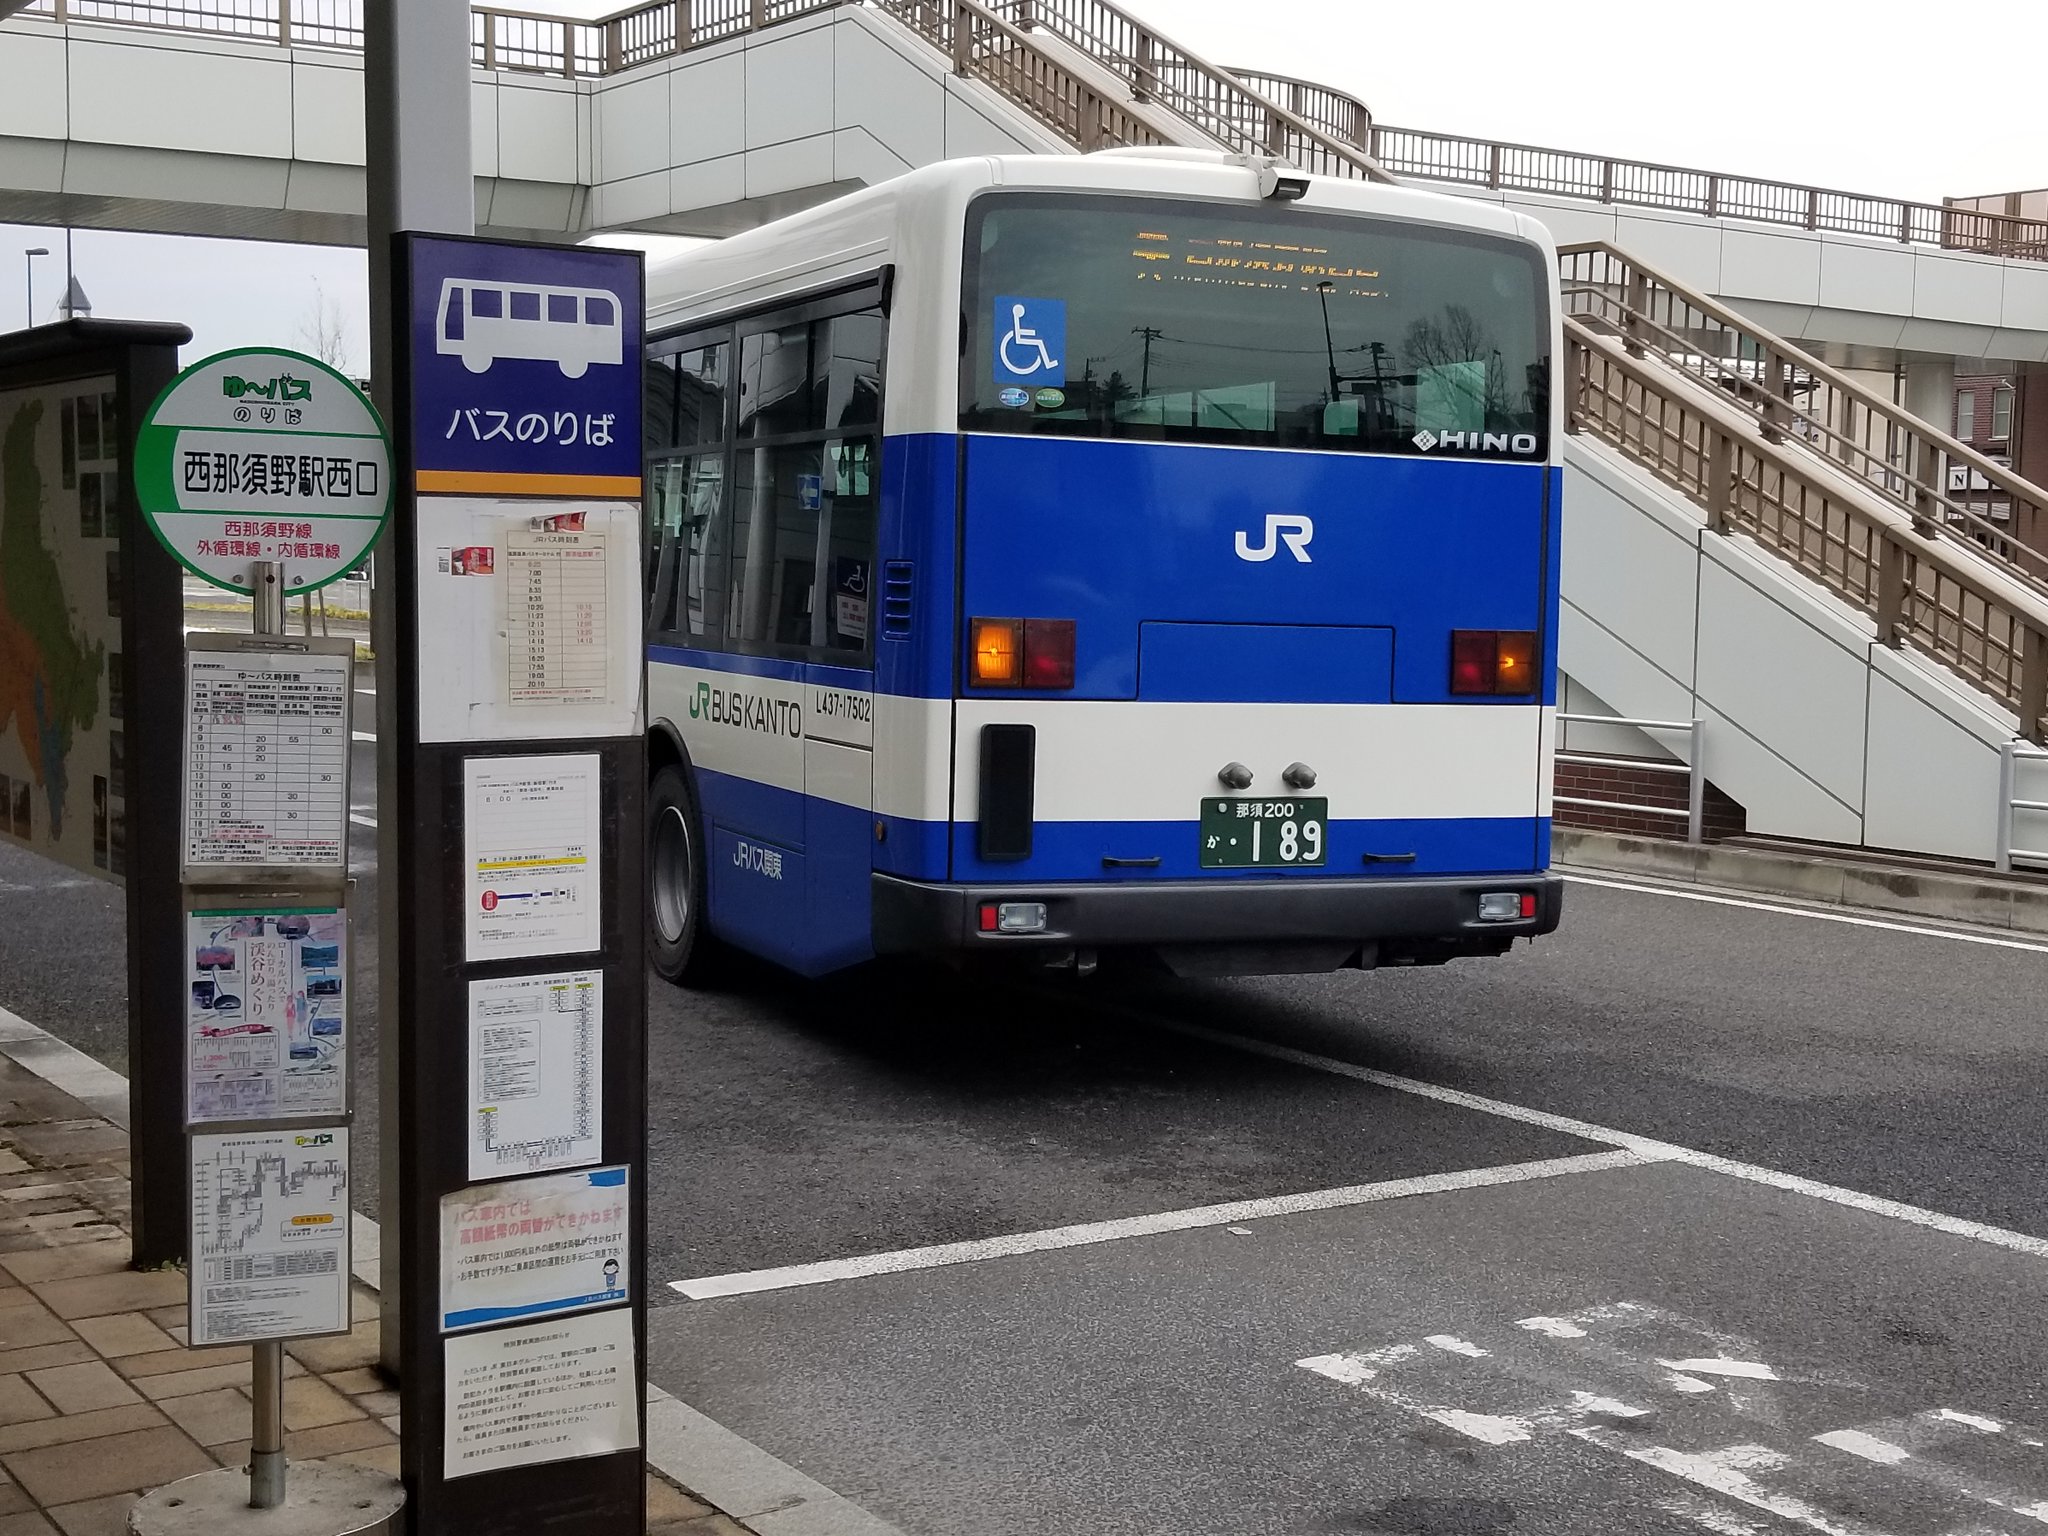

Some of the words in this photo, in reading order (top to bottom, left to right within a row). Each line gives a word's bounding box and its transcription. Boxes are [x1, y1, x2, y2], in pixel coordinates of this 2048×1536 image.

[233, 406, 303, 425] のりば
[445, 407, 616, 447] バスのりば
[1439, 430, 1537, 453] HINO
[184, 451, 378, 498] 西那須野駅西口
[224, 520, 313, 539] 西那須野線
[1234, 513, 1314, 563] JR
[197, 539, 341, 559] 外循環線・内循環線
[689, 681, 711, 721] JR
[712, 689, 742, 727] BUS
[744, 694, 801, 739] KANTO
[816, 689, 871, 723] L437-17502
[197, 724, 203, 732] 8
[255, 754, 266, 762] 20
[255, 773, 266, 781] 20
[321, 774, 332, 782] 30
[221, 791, 232, 799] 00
[221, 810, 231, 818] 00
[287, 811, 298, 819] 30
[1236, 803, 1295, 818] 那須200
[1206, 834, 1221, 849] か
[453, 1200, 531, 1225] バス車内では
